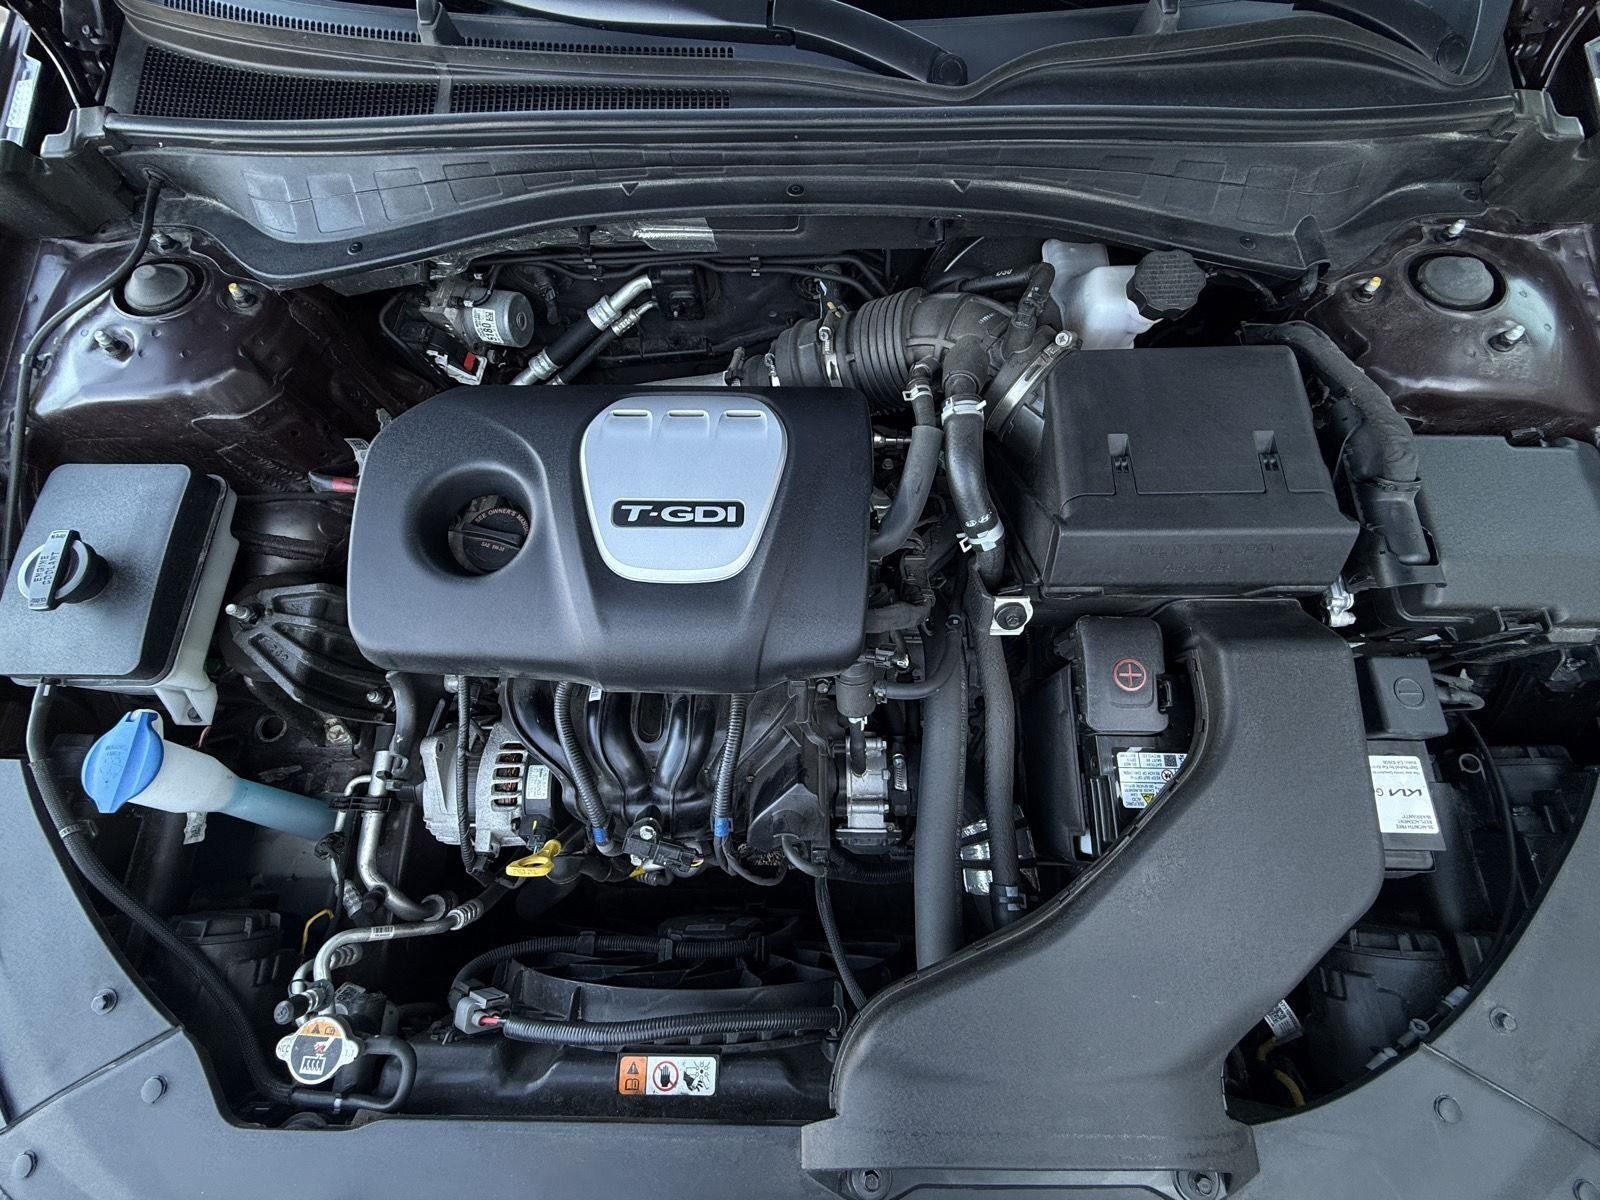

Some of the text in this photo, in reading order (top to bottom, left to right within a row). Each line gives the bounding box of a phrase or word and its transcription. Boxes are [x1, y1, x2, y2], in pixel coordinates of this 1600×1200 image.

[621, 504, 737, 523] T-GDI
[34, 556, 49, 582] ENGINE
[43, 552, 59, 584] COOLANT
[1389, 789, 1422, 797] KIA
